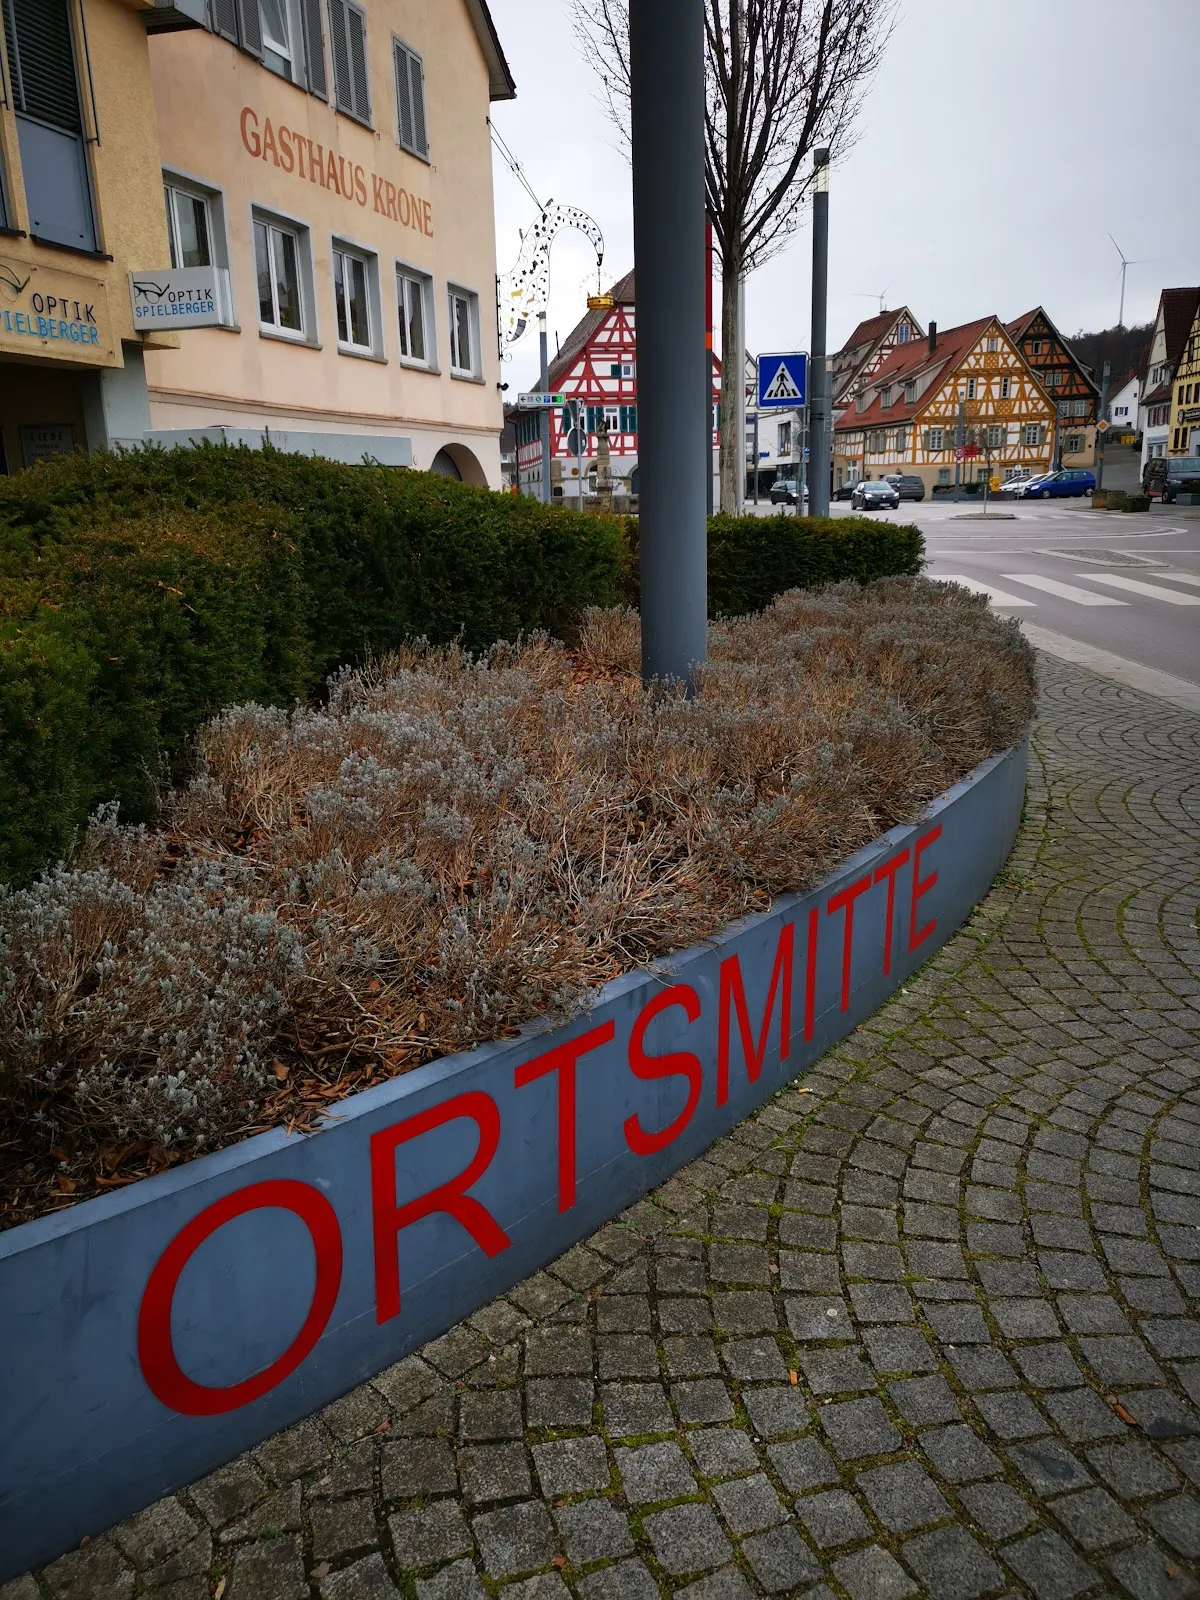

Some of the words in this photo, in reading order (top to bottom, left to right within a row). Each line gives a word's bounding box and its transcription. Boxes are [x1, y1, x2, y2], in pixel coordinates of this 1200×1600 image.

[239, 106, 367, 207] GASTHAUS
[371, 173, 434, 238] KRONE
[32, 293, 97, 323] OPTIK
[135, 301, 215, 317] SPIELBERGER
[168, 288, 213, 303] OPTIK
[0, 310, 100, 345] IELBERGER
[137, 825, 943, 1416] ORTSMITTE
